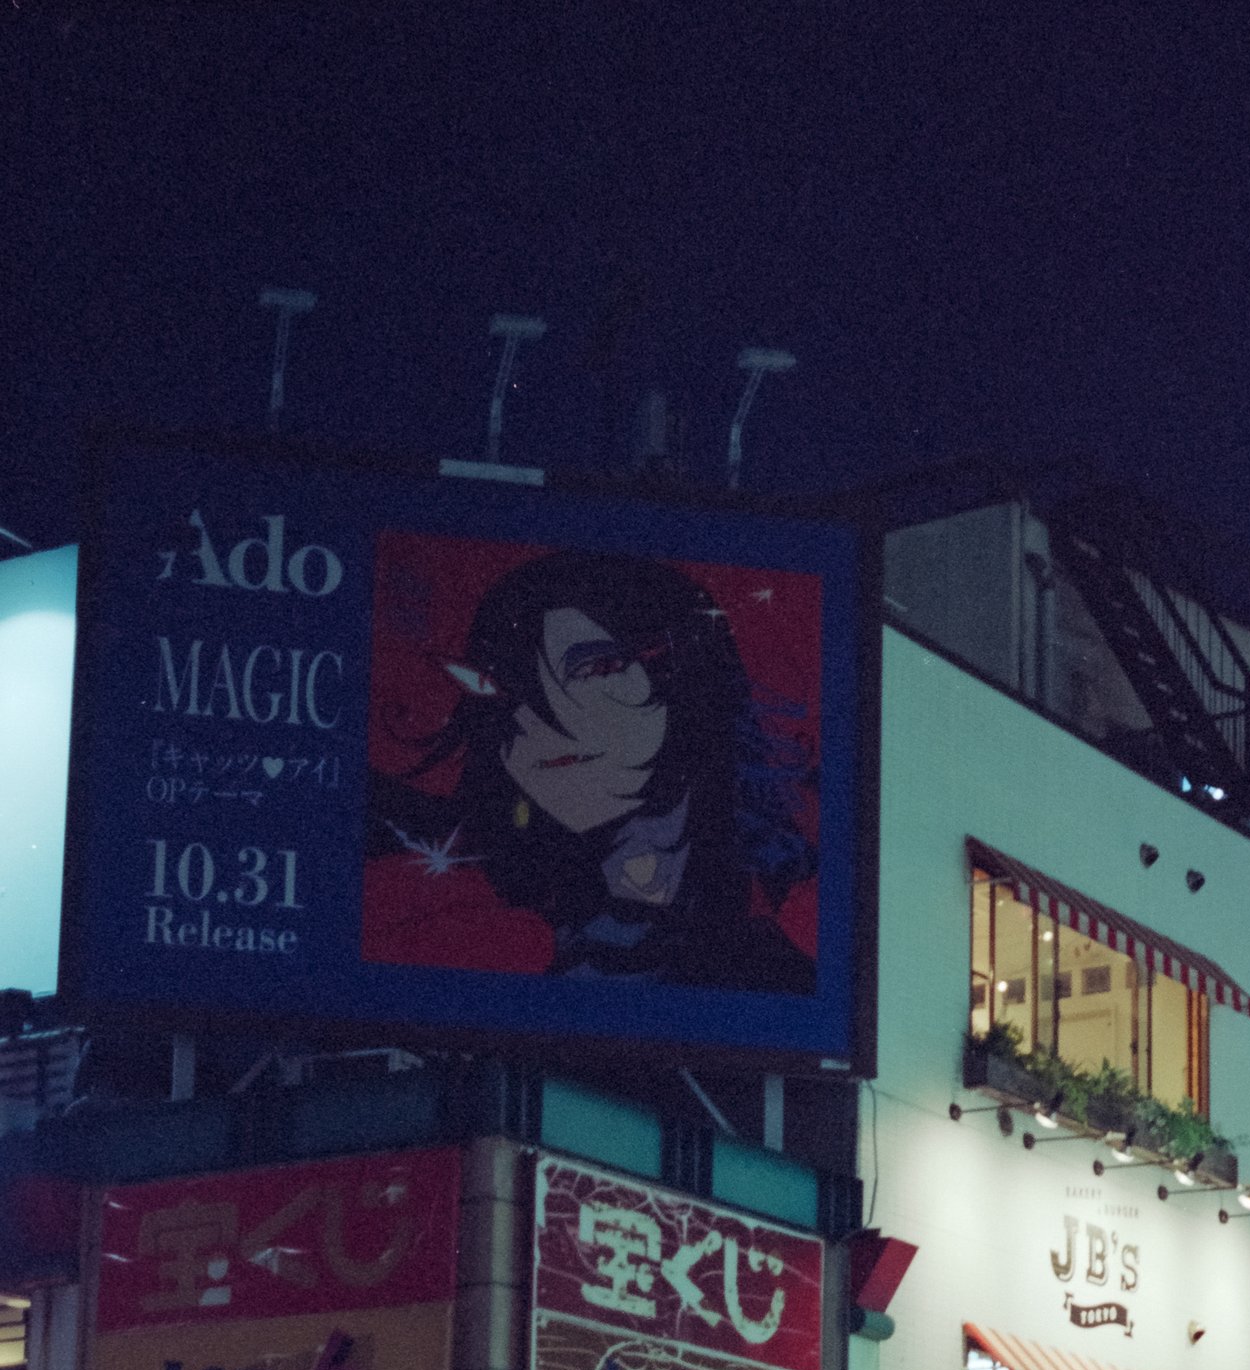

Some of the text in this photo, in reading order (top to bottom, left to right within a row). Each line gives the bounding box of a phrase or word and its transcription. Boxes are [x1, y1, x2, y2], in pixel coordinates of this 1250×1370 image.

[157, 509, 343, 596] Ado
[155, 636, 342, 728] MAGIC
[146, 840, 304, 908] 10.31
[146, 906, 297, 953] Release
[138, 1181, 411, 1311] 宝くじ
[580, 1203, 785, 1343] 宝くじ
